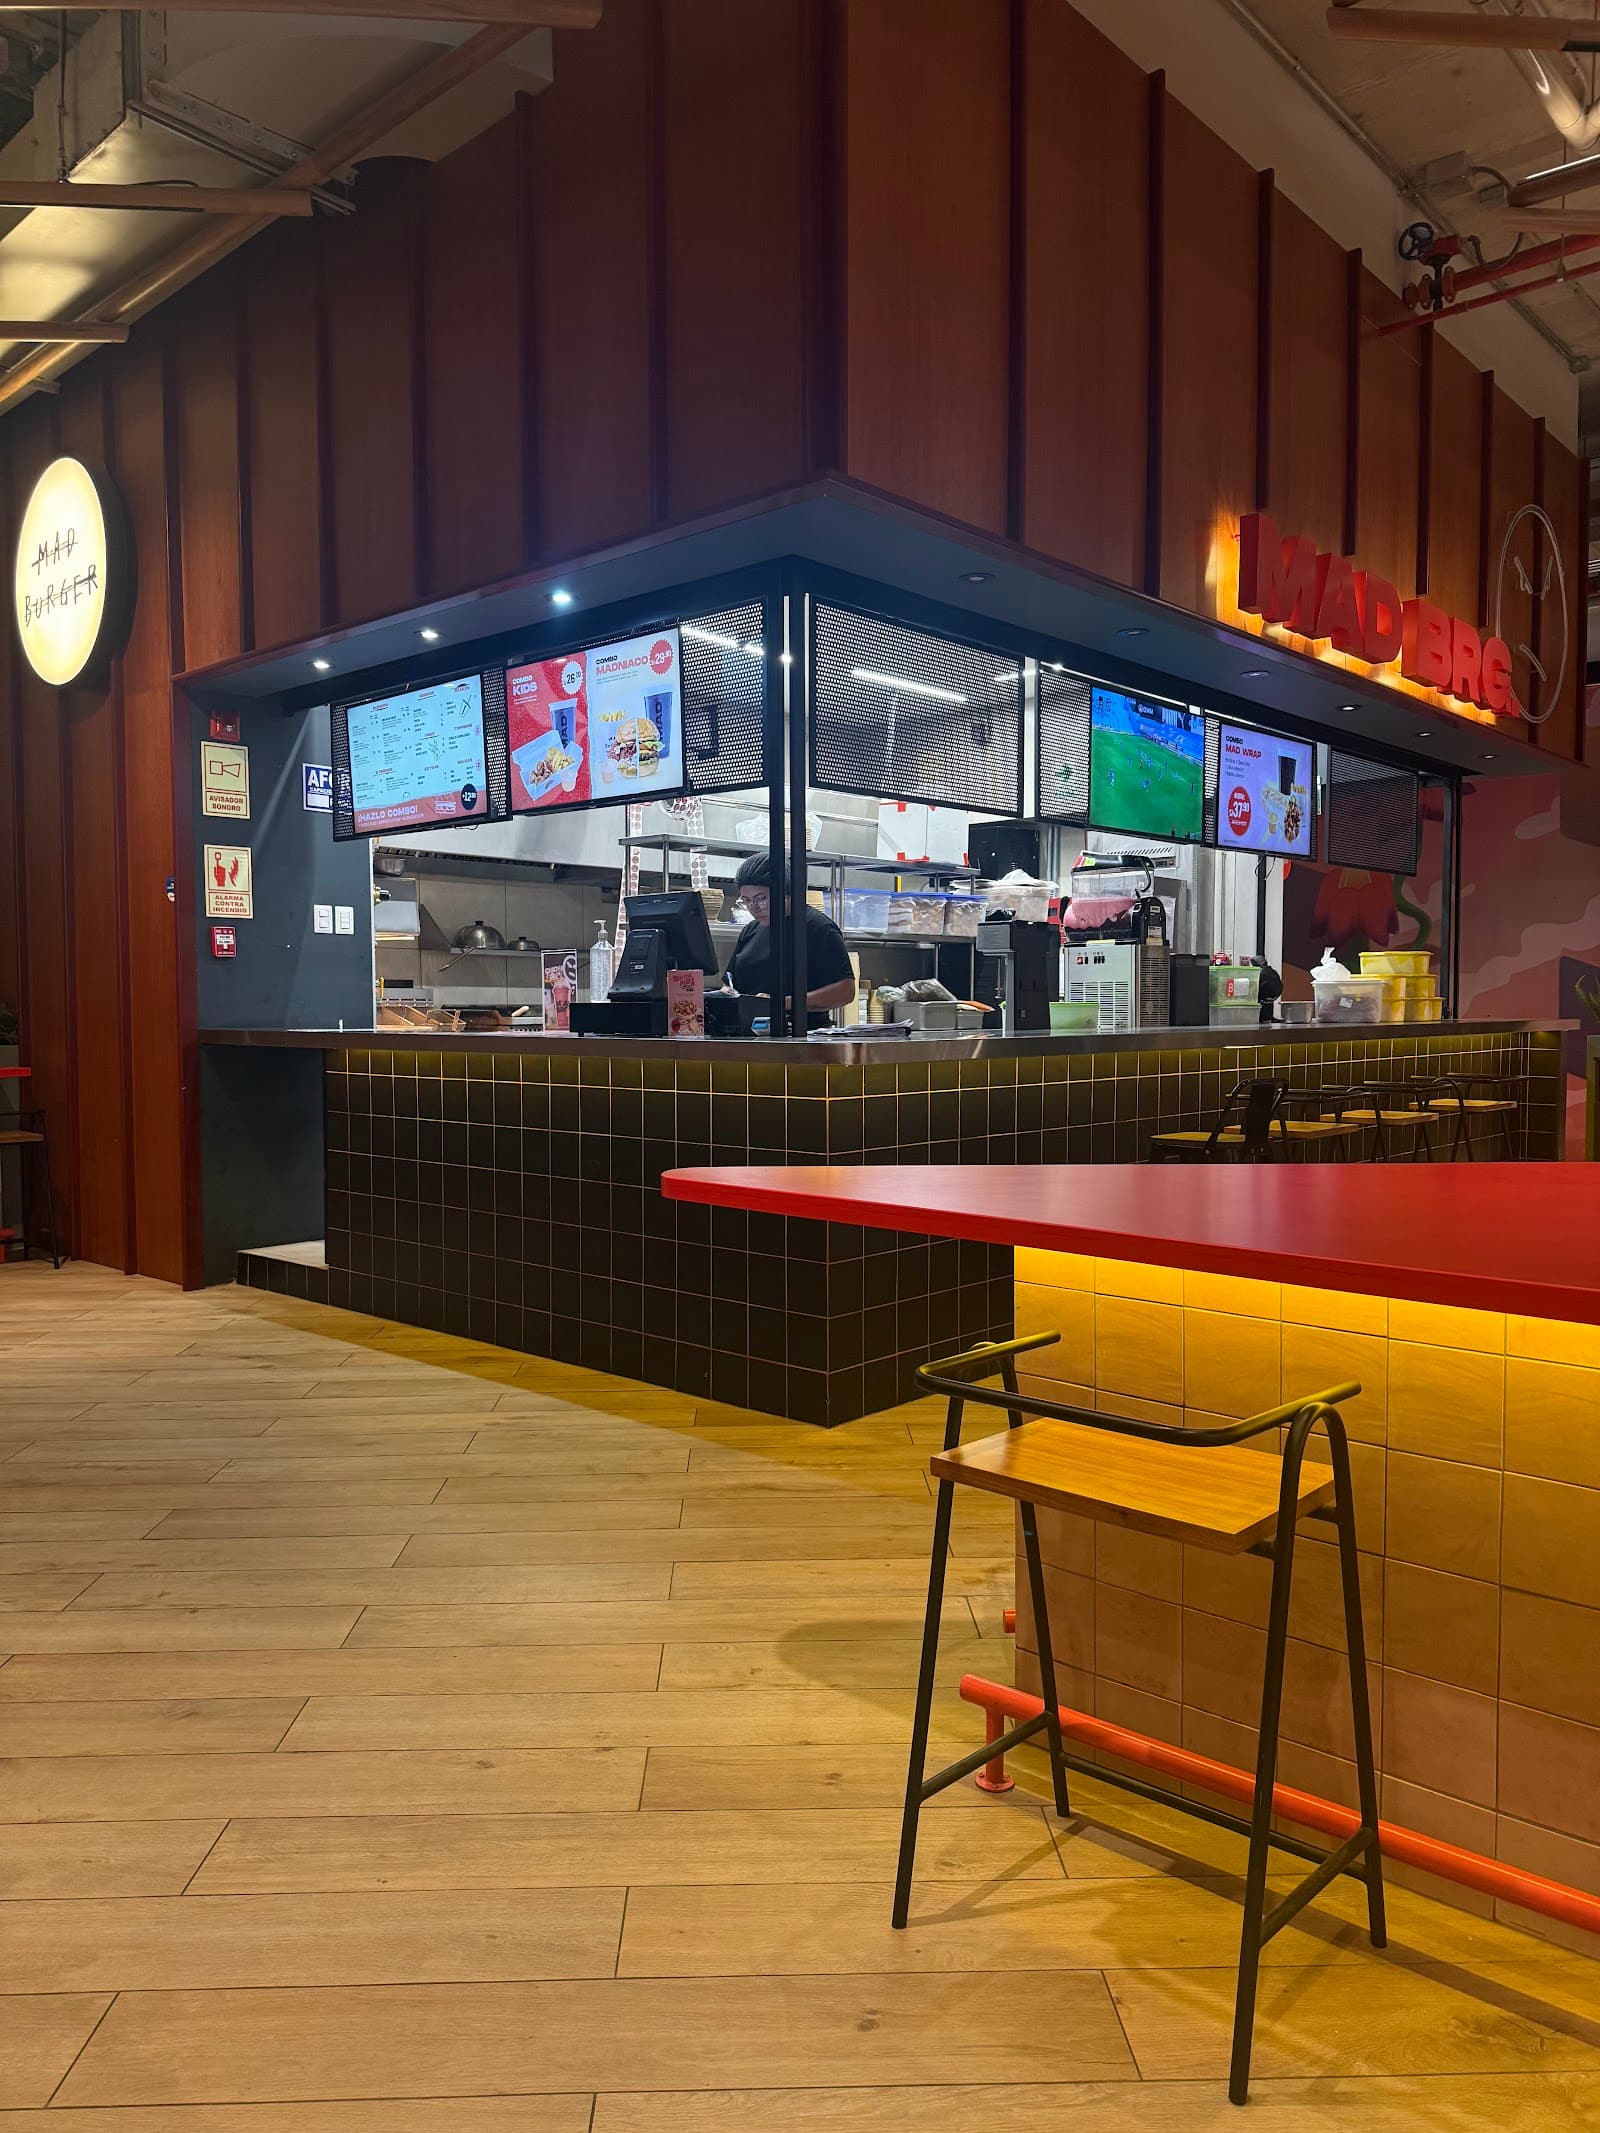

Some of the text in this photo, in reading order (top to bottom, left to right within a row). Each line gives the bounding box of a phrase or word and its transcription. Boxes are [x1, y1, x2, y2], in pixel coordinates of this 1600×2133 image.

[34, 527, 78, 576] MAD
[24, 564, 98, 627] BURGER
[1239, 512, 1402, 664] MAD
[595, 655, 618, 665] COMBO
[596, 656, 649, 675] MADNIACO
[512, 674, 533, 685] COMBO
[512, 681, 538, 696] KIDS
[1225, 735, 1244, 745] COMBO
[1225, 743, 1262, 759] MAD WRAP
[209, 795, 244, 804] AVISADOR
[212, 803, 241, 812] SONORO
